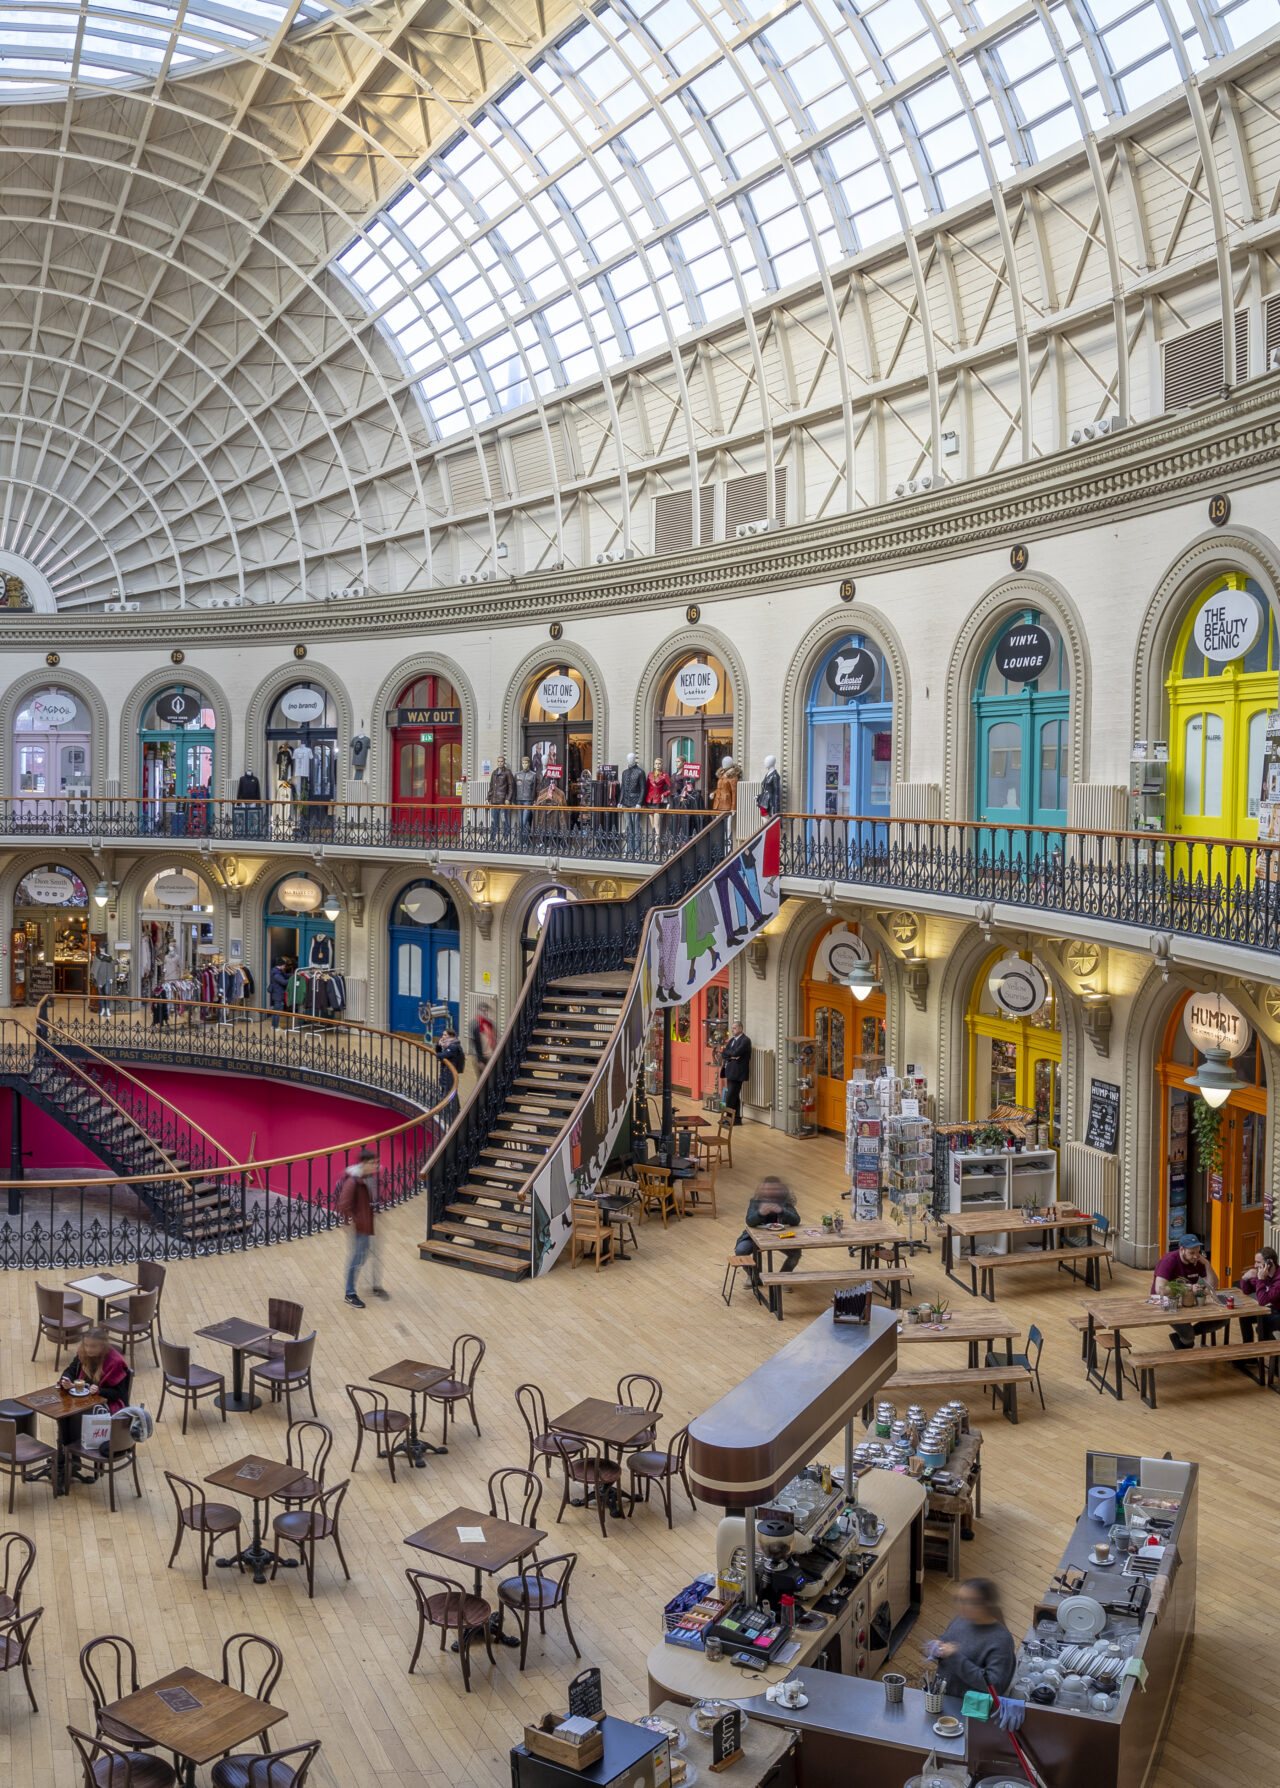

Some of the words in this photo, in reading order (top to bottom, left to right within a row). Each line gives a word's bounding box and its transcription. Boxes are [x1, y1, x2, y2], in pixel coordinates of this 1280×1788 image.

[1211, 500, 1225, 518] 13
[1011, 550, 1023, 564] 14
[841, 584, 851, 595] 15
[687, 608, 696, 618] 16
[1205, 607, 1226, 623] THE
[551, 625, 558, 635] 17
[1204, 618, 1248, 638] BEAUTY
[1010, 634, 1038, 647] VINYL
[1204, 634, 1240, 652] CLINIC
[173, 652, 182, 661] 19
[295, 647, 305, 655] 18
[47, 655, 58, 663] 20
[1003, 655, 1043, 669] LOUNGE
[680, 673, 696, 687] NEXT
[697, 672, 711, 686] ONE
[543, 683, 558, 697] NEXT
[559, 684, 573, 697] ONE
[298, 702, 317, 710] brand)
[407, 711, 429, 722] WAY
[433, 711, 454, 722] OUT
[546, 769, 561, 778] RAIL
[684, 769, 699, 778] RAIL
[1006, 980, 1027, 992] Yellow
[101, 1049, 117, 1057] OUR
[119, 1050, 139, 1059] PAST
[142, 1052, 173, 1063] SHAPES
[175, 1055, 191, 1063] OUR
[227, 1060, 251, 1072] BLOCK
[253, 1063, 263, 1073] BY
[265, 1065, 287, 1077] BLOCK
[290, 1070, 301, 1078] WE
[302, 1073, 322, 1084] BUILD
